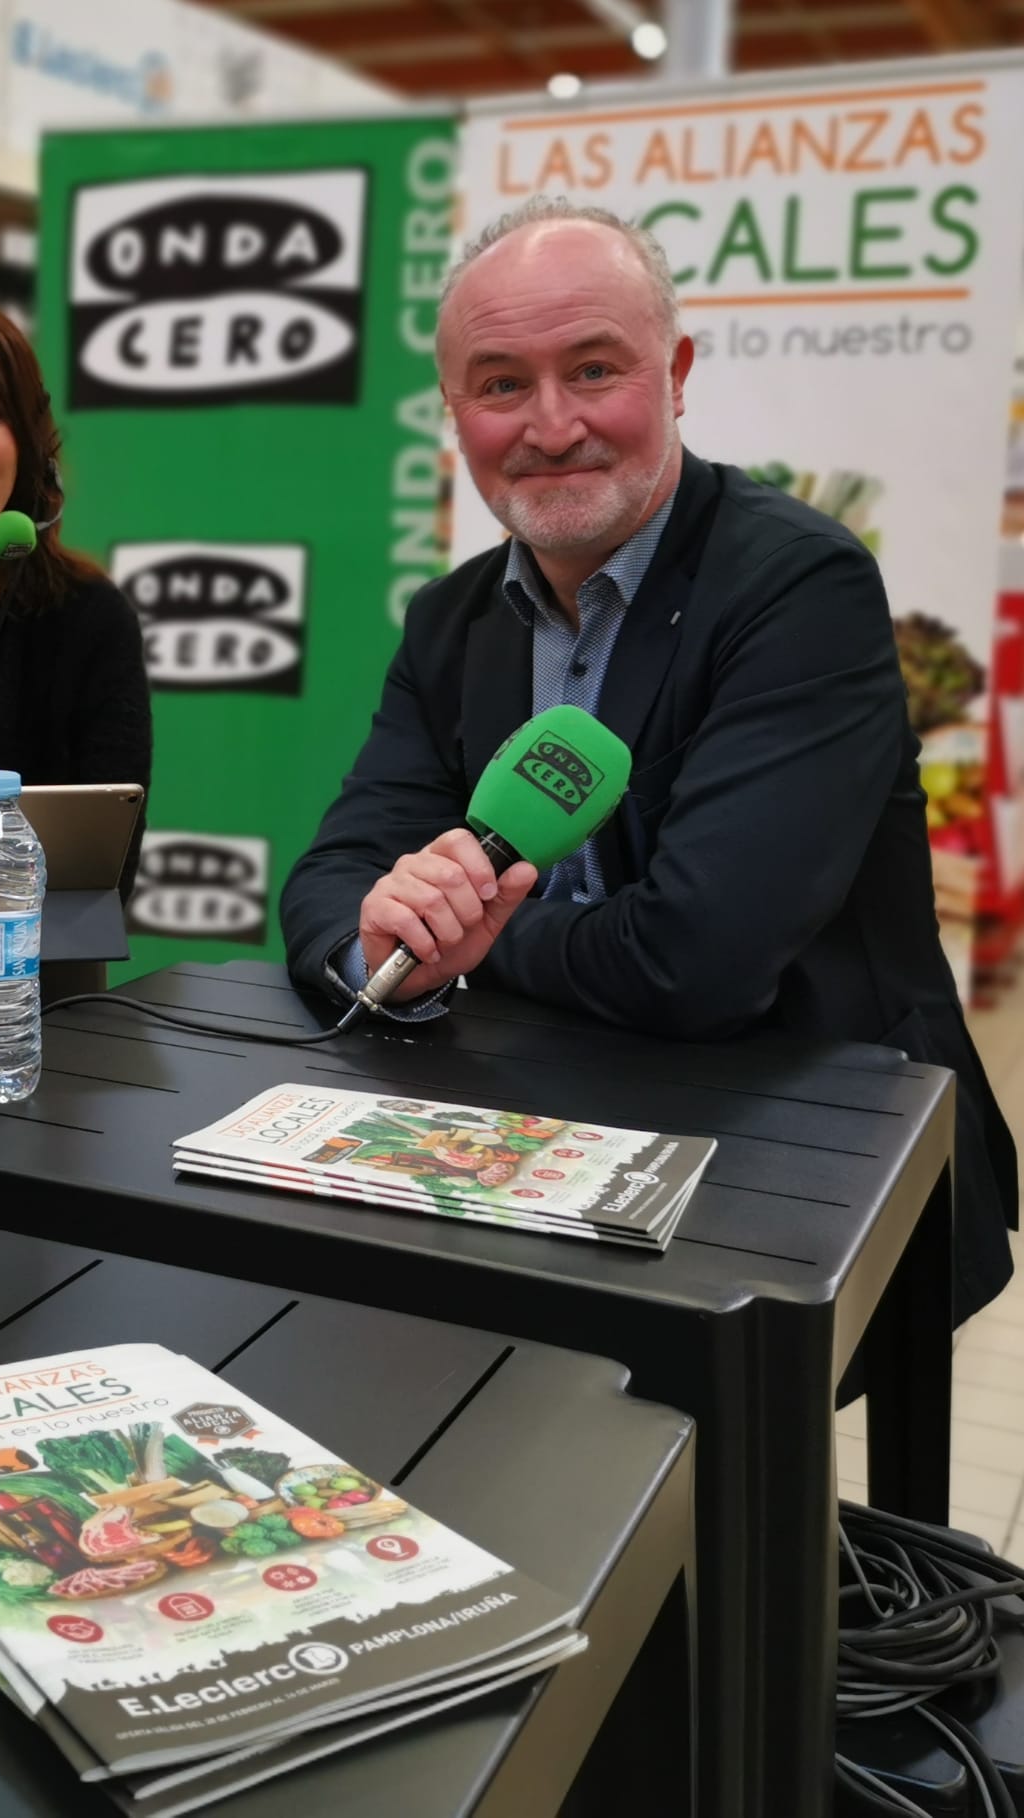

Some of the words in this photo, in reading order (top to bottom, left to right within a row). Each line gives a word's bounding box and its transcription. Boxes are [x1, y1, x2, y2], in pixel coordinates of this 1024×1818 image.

[497, 133, 614, 194] LAS
[635, 103, 986, 185] ALIANZAS
[106, 222, 318, 278] ONDA
[399, 137, 454, 353] CERO
[640, 184, 980, 286] CALES
[117, 314, 316, 369] CERO
[729, 321, 770, 358] lo
[794, 315, 973, 357] nuestro
[134, 571, 276, 606] ONDA
[531, 763, 575, 799] CERO
[542, 744, 589, 784] ONDA
[248, 1098, 335, 1144] LOCALES
[11, 1425, 41, 1437] es
[42, 1419, 70, 1434] lo
[76, 1398, 169, 1424] nuestro
[183, 1410, 242, 1427] ALIANZA
[118, 1663, 297, 1718] E.Leclerc
[349, 1591, 518, 1656] PAMPLONA/IRUÑA
